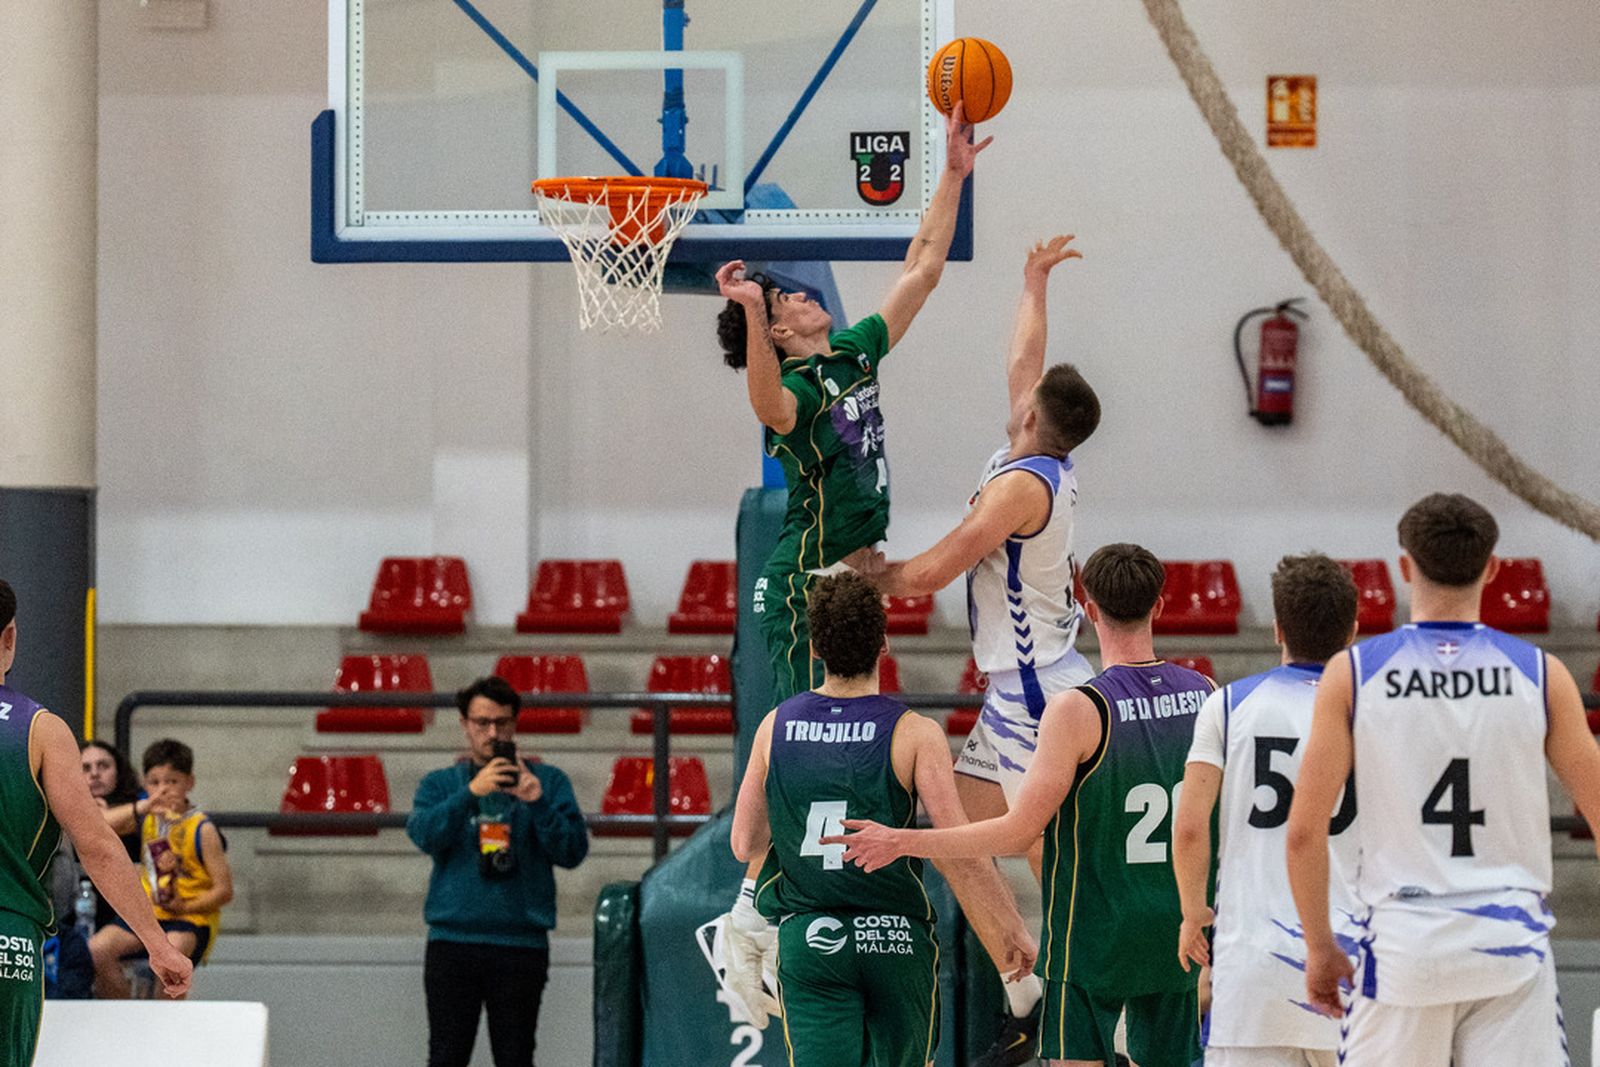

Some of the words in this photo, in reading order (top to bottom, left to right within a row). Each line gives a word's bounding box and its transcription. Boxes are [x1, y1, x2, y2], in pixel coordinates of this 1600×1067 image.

[941, 56, 956, 111] Wilson
[855, 136, 905, 153] LIGA
[860, 165, 871, 182] 2
[890, 165, 901, 182] 2
[1386, 667, 1513, 699] SARDUI
[1116, 698, 1136, 722] DE
[1136, 697, 1152, 719] LA
[785, 720, 877, 743] TRUJILLO
[1421, 758, 1486, 857] 4
[1124, 781, 1184, 864] 2
[800, 801, 848, 870] 4
[853, 915, 911, 928] COSTA
[855, 930, 885, 941] DEL
[888, 930, 913, 942] SOL
[856, 940, 913, 955] MÁLAGA
[15, 954, 35, 968] SOL
[730, 1025, 764, 1067] 2
